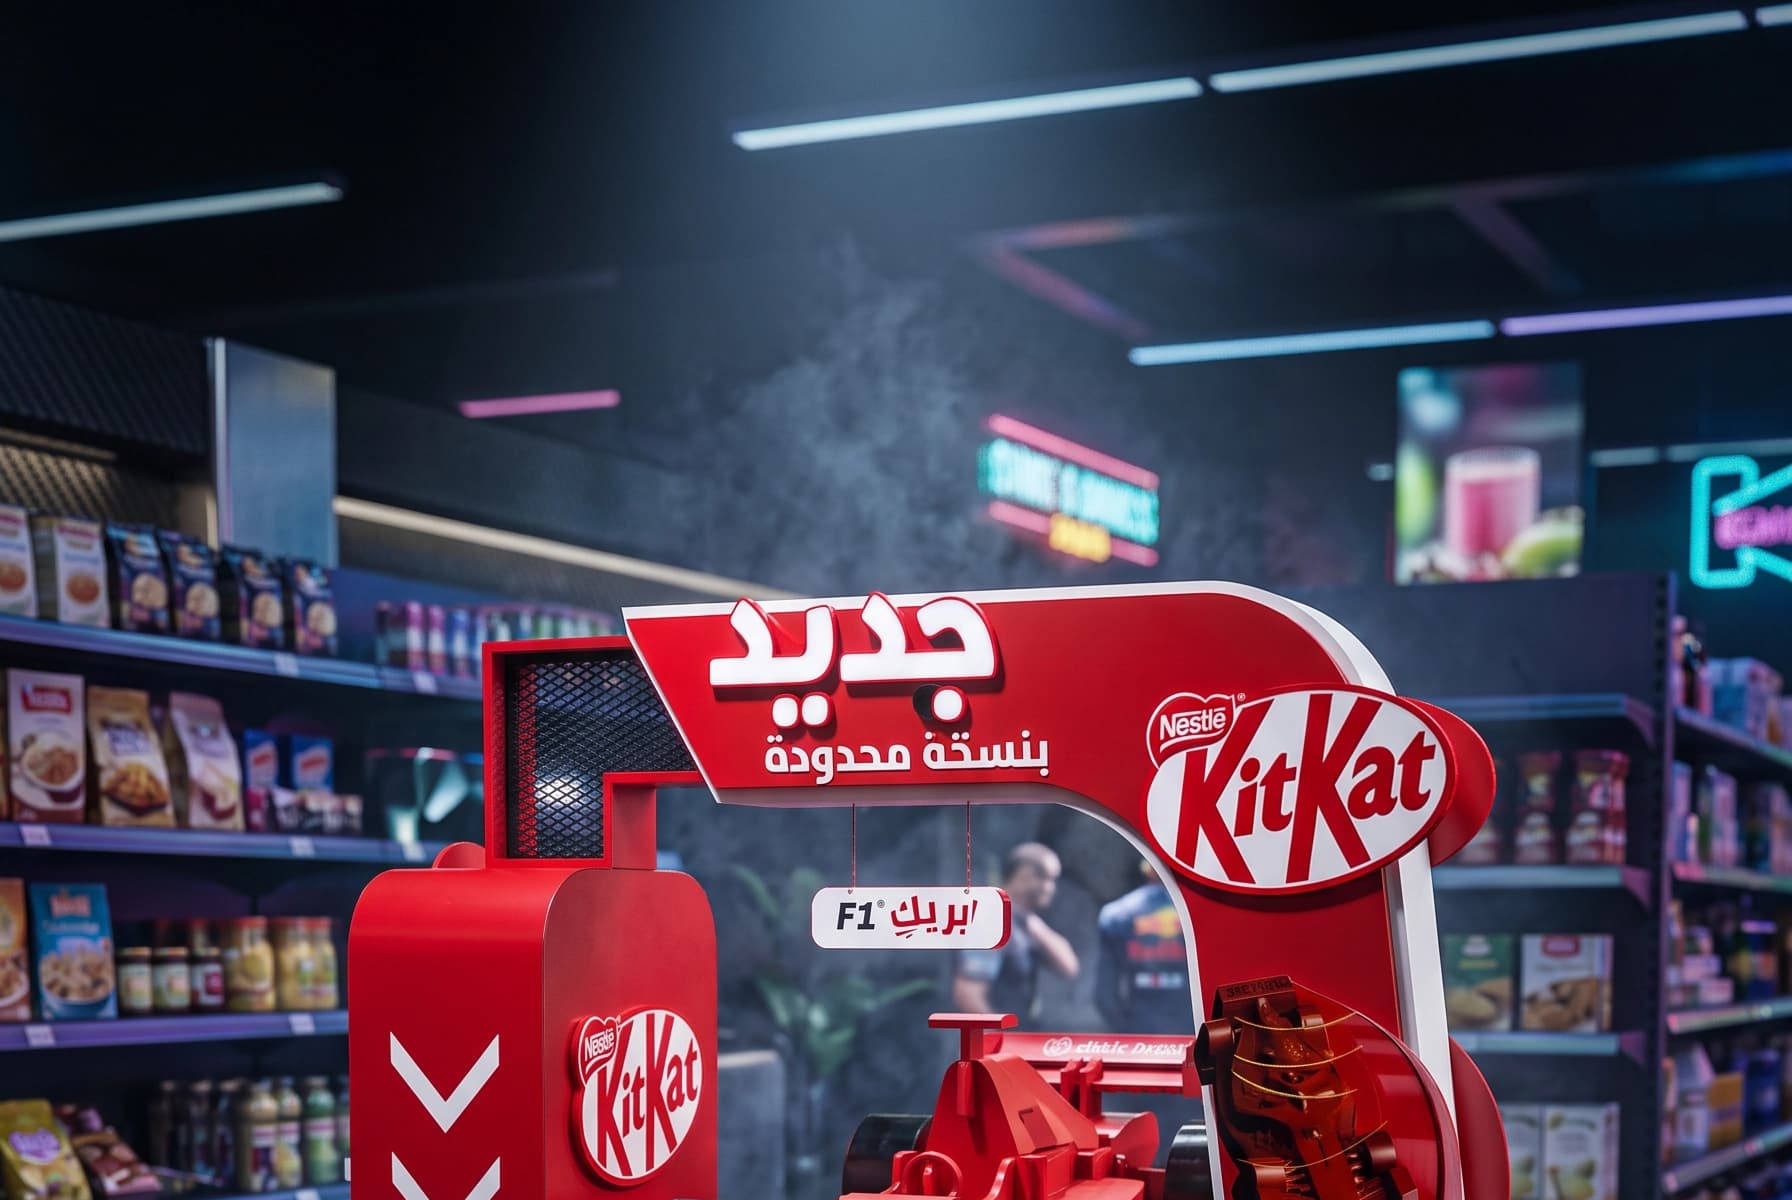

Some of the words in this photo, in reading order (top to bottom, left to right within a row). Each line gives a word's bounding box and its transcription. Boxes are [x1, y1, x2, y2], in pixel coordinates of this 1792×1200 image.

[708, 591, 998, 728] جديد
[765, 735, 911, 784] محدودة
[1174, 692, 1437, 885] KitKat
[597, 1012, 698, 1177] KitKat
